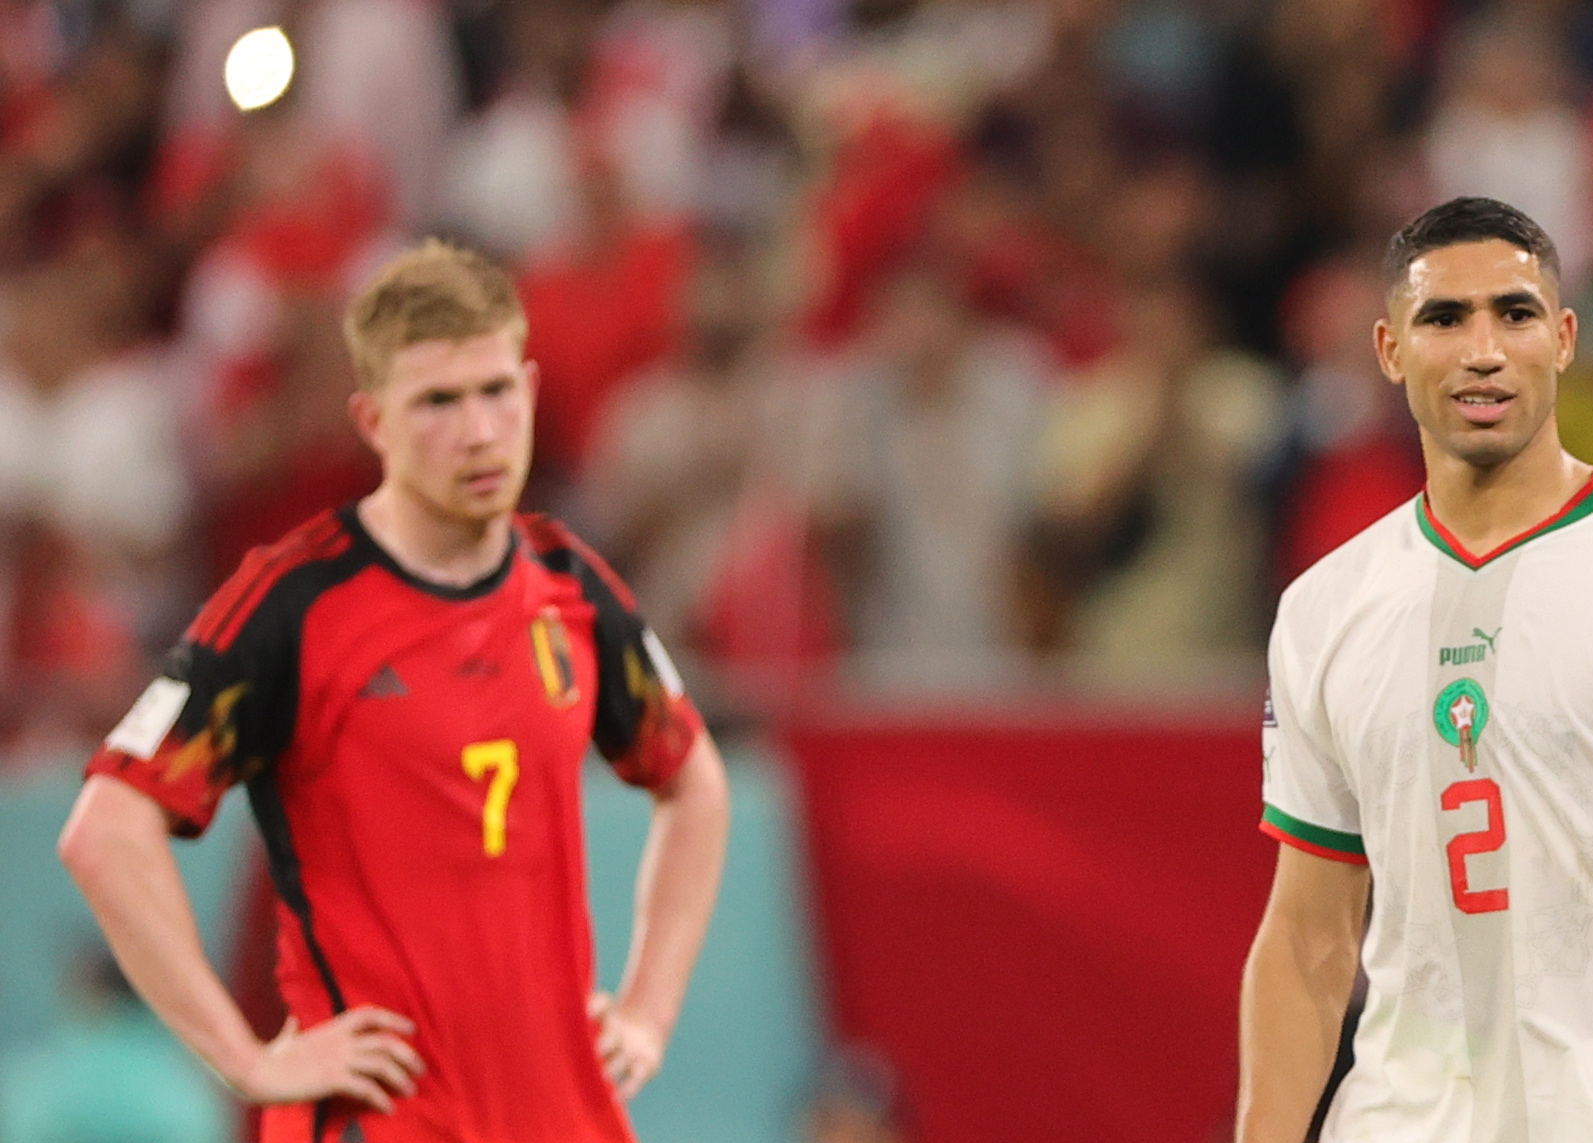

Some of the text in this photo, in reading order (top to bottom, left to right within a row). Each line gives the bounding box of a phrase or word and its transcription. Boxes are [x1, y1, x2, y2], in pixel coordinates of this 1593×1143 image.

[1439, 643, 1486, 666] PUMA
[461, 738, 520, 858] 7
[1440, 777, 1510, 915] 2
